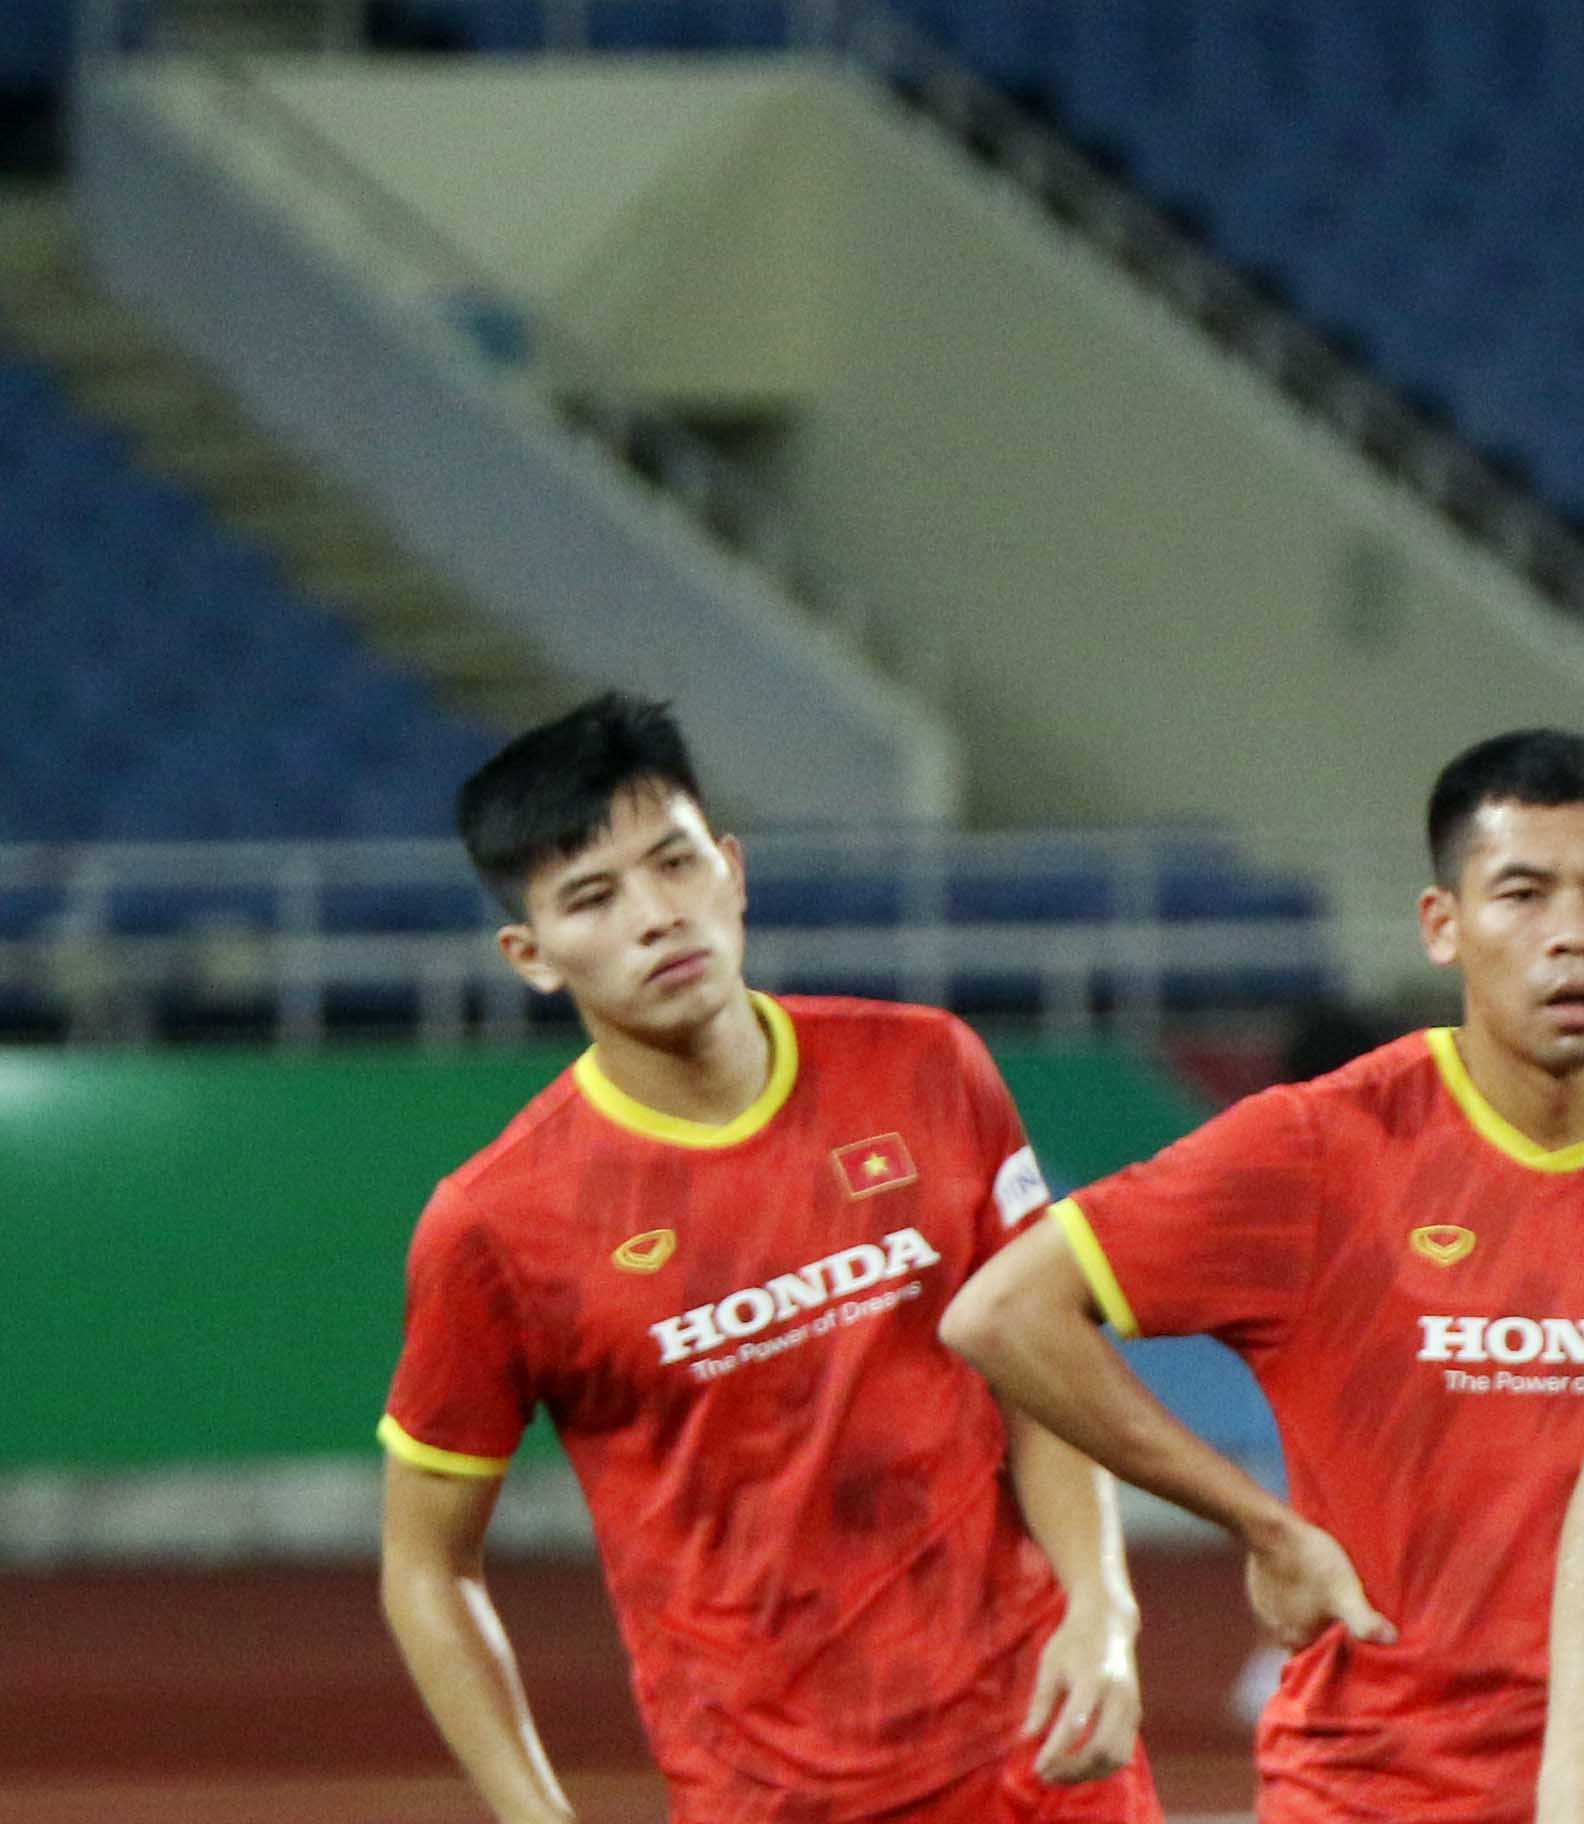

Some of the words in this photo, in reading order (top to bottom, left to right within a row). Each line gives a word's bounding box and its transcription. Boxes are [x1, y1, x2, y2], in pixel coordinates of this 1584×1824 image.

[650, 1227, 941, 1364] HONDA
[689, 1355, 737, 1382] The
[738, 1324, 807, 1361] Power
[812, 1312, 837, 1336] of
[1445, 1370, 1489, 1393] The
[1495, 1371, 1570, 1394] Power
